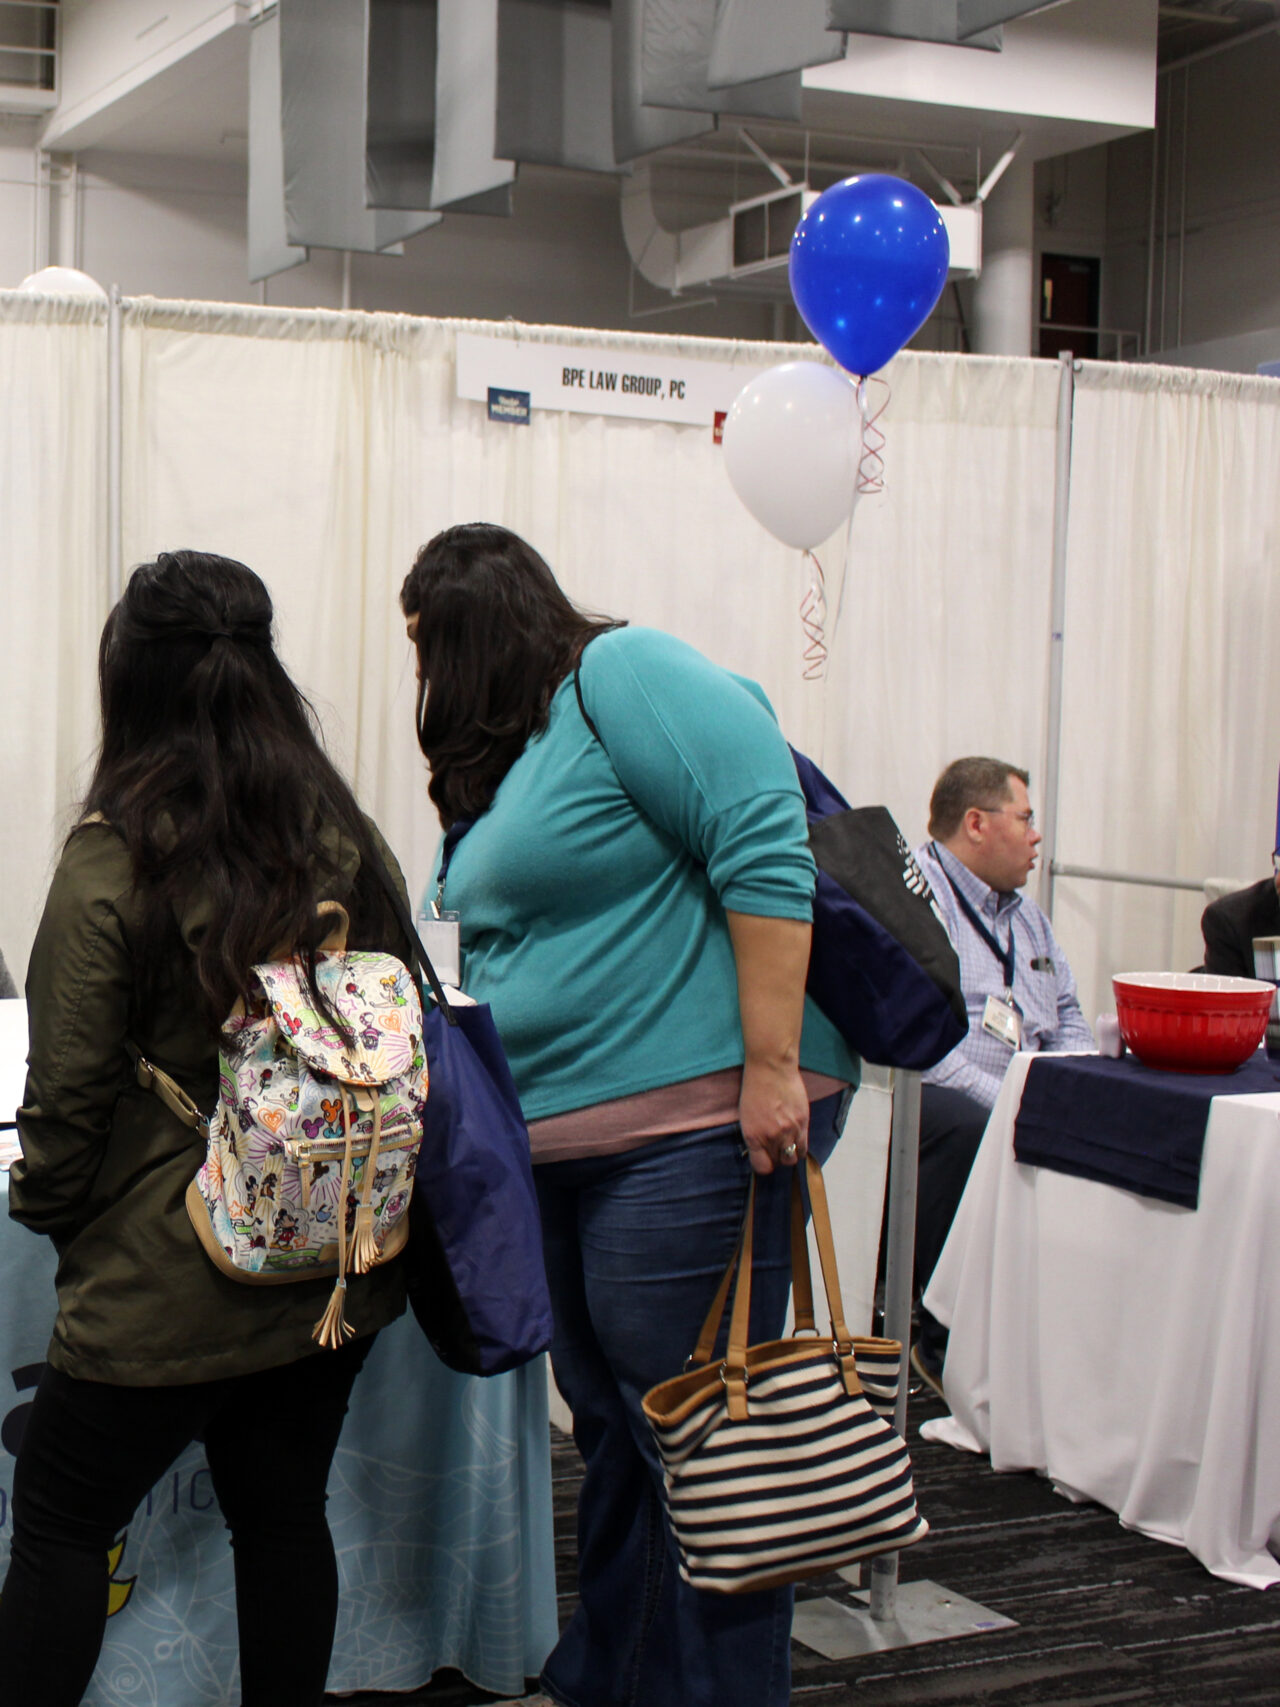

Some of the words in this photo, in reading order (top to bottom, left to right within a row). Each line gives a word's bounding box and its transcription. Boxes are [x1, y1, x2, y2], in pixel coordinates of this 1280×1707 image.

[562, 367, 586, 389] BPE
[589, 370, 618, 392] LAW
[622, 374, 666, 400] GROUP,
[669, 380, 686, 400] PC
